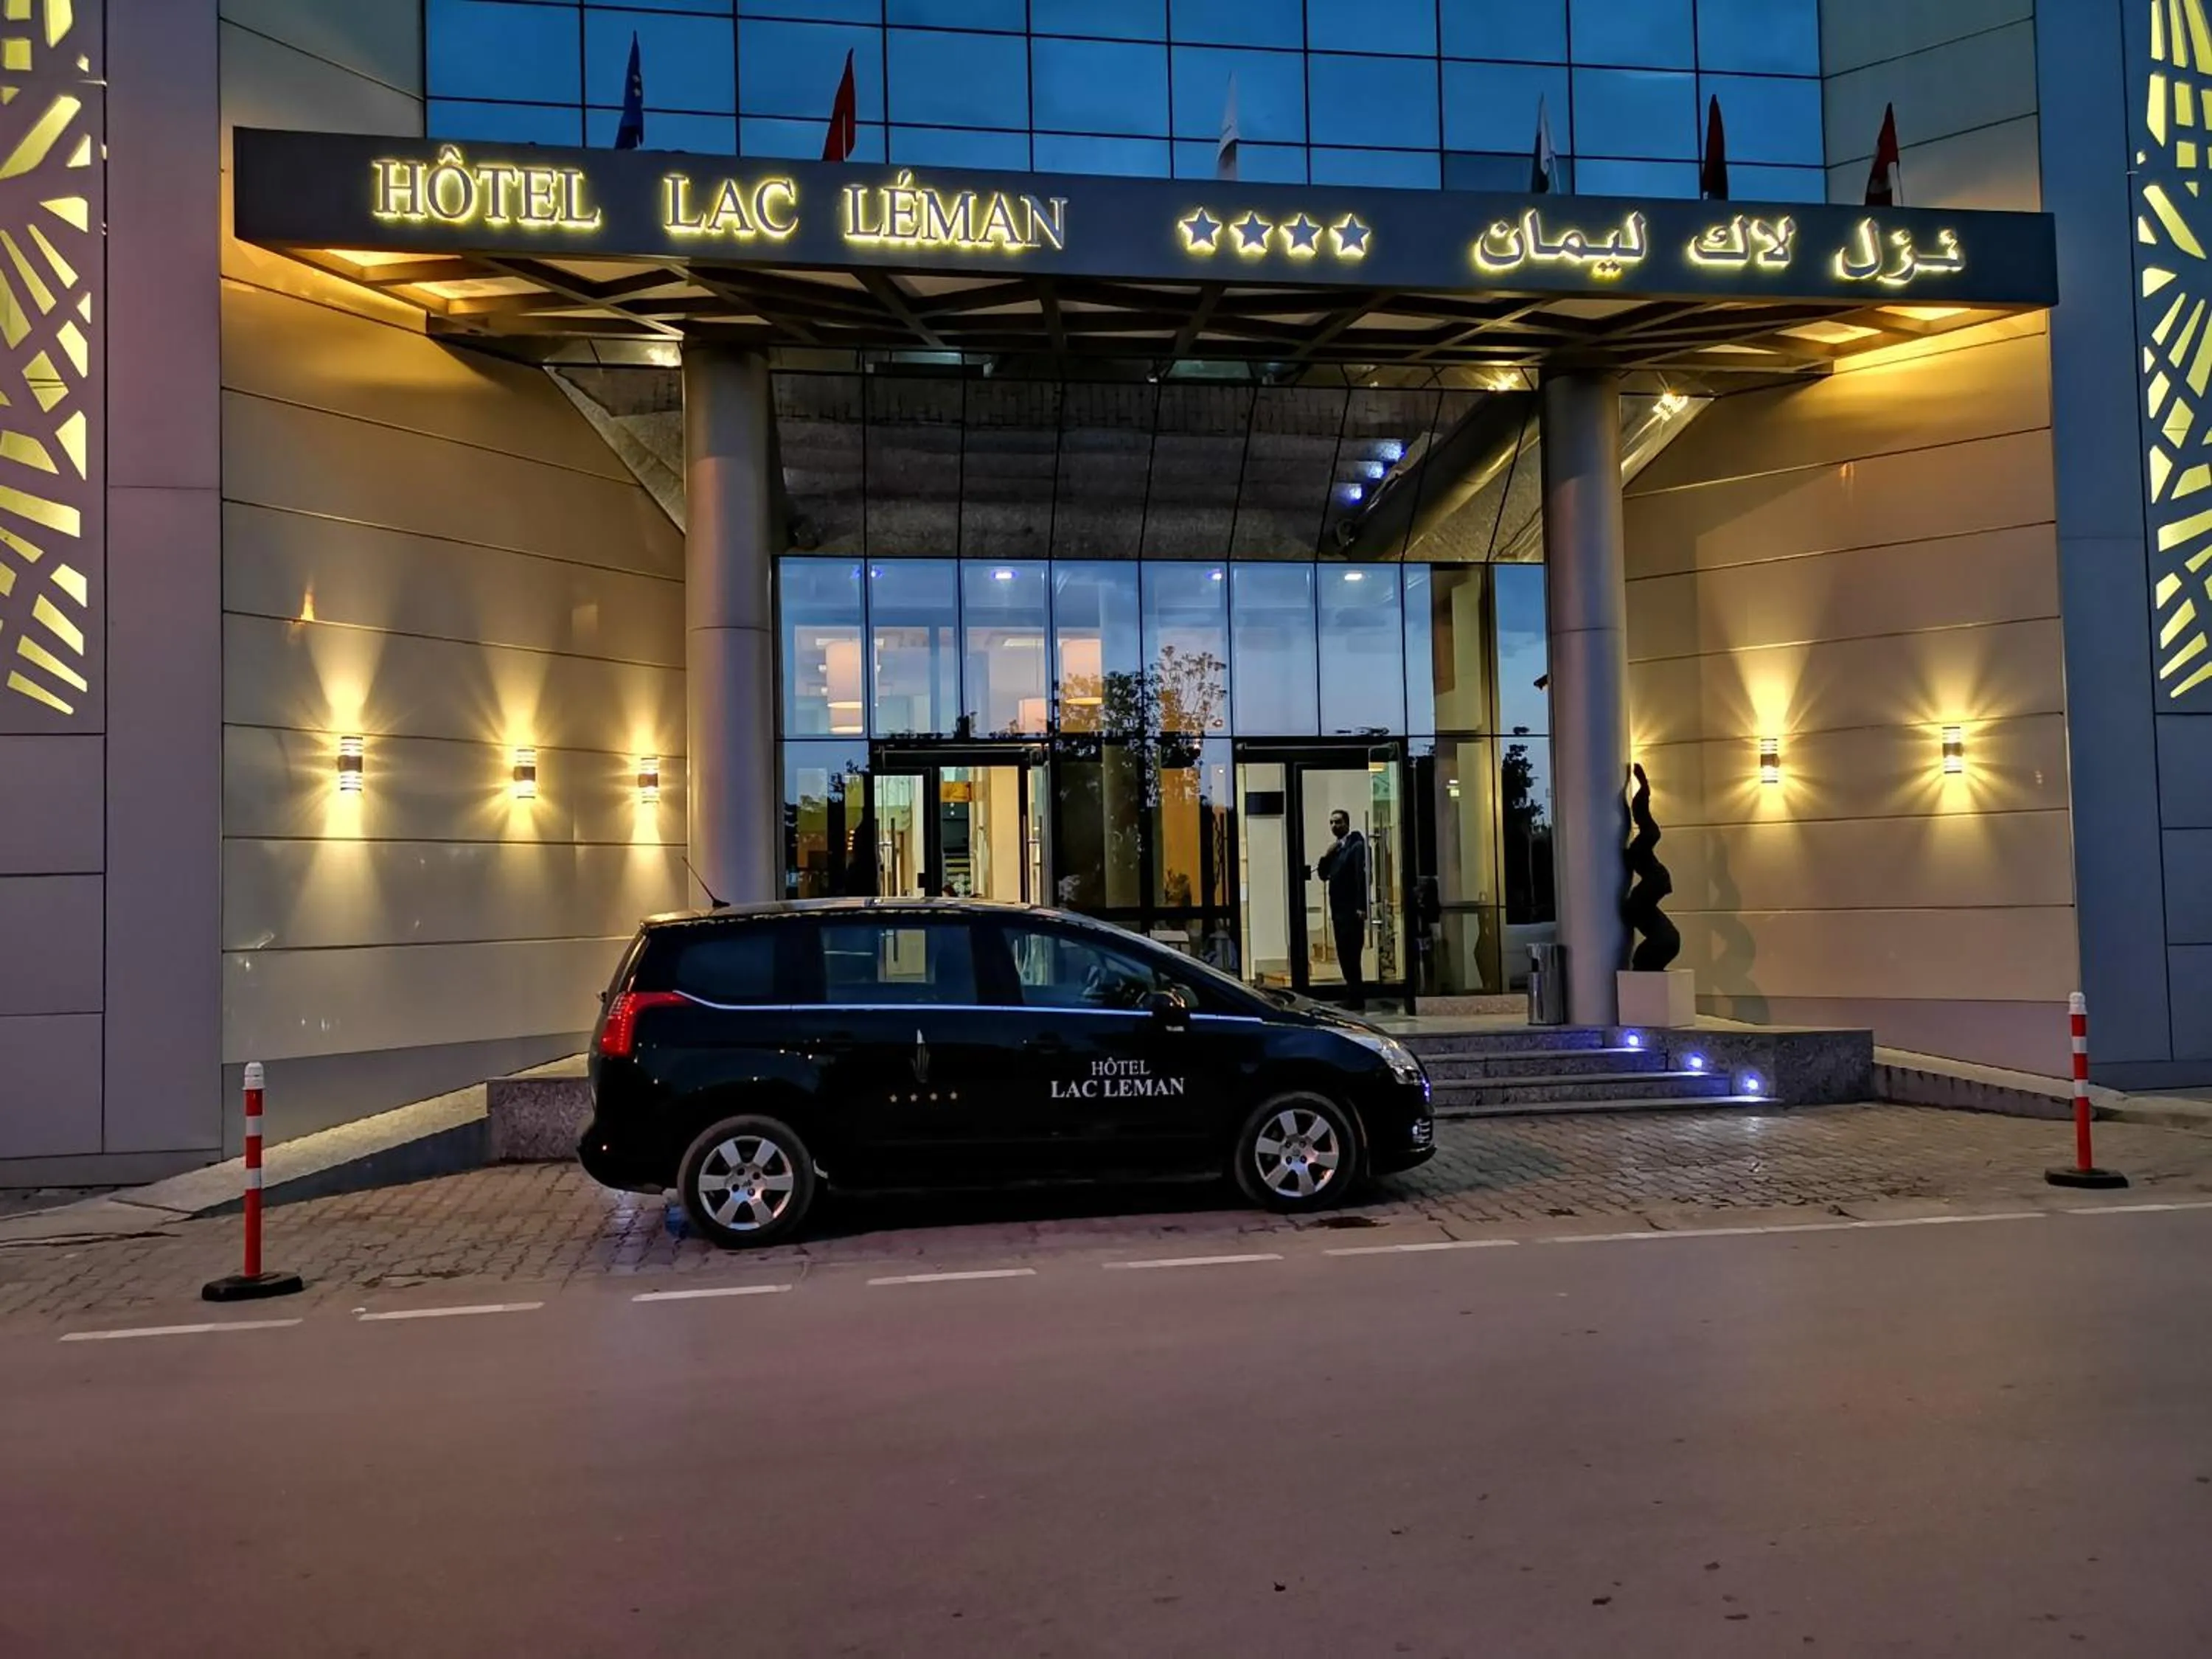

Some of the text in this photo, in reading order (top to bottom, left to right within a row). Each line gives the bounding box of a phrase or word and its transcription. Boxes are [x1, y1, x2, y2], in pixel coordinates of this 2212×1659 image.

[371, 144, 1068, 249] HÔTEL LAC LÉMAN
[1475, 208, 1966, 285] نزل لاك ليمان
[1050, 1077, 1185, 1098] LAC LEMAN
[1091, 1057, 1151, 1076] HÔTEL
